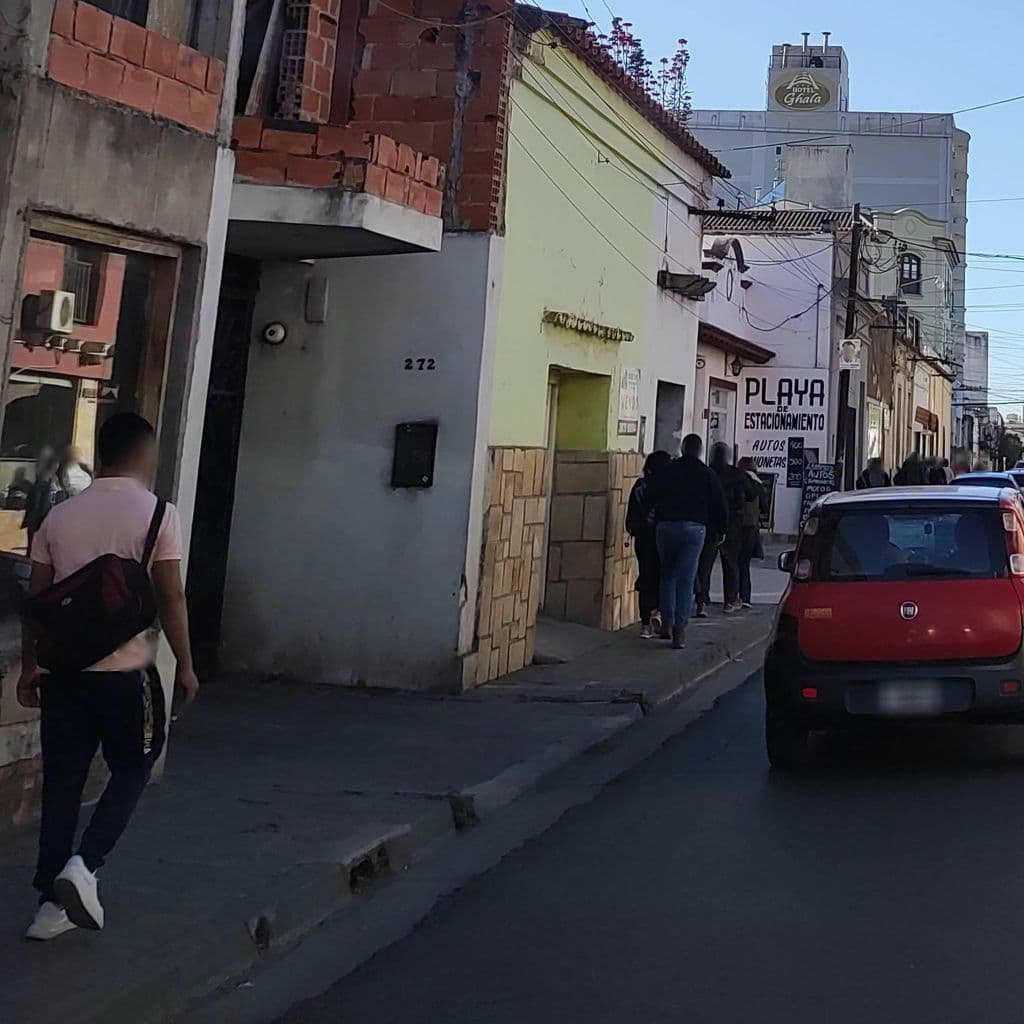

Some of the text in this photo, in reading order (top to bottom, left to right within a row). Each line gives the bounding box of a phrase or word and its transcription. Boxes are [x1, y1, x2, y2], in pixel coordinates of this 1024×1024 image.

[784, 92, 823, 106] Ghala
[404, 358, 436, 371] 272
[745, 377, 825, 407] PLAYA
[744, 412, 825, 431] ESTACIONAMIENTO
[752, 439, 786, 452] AUTOS
